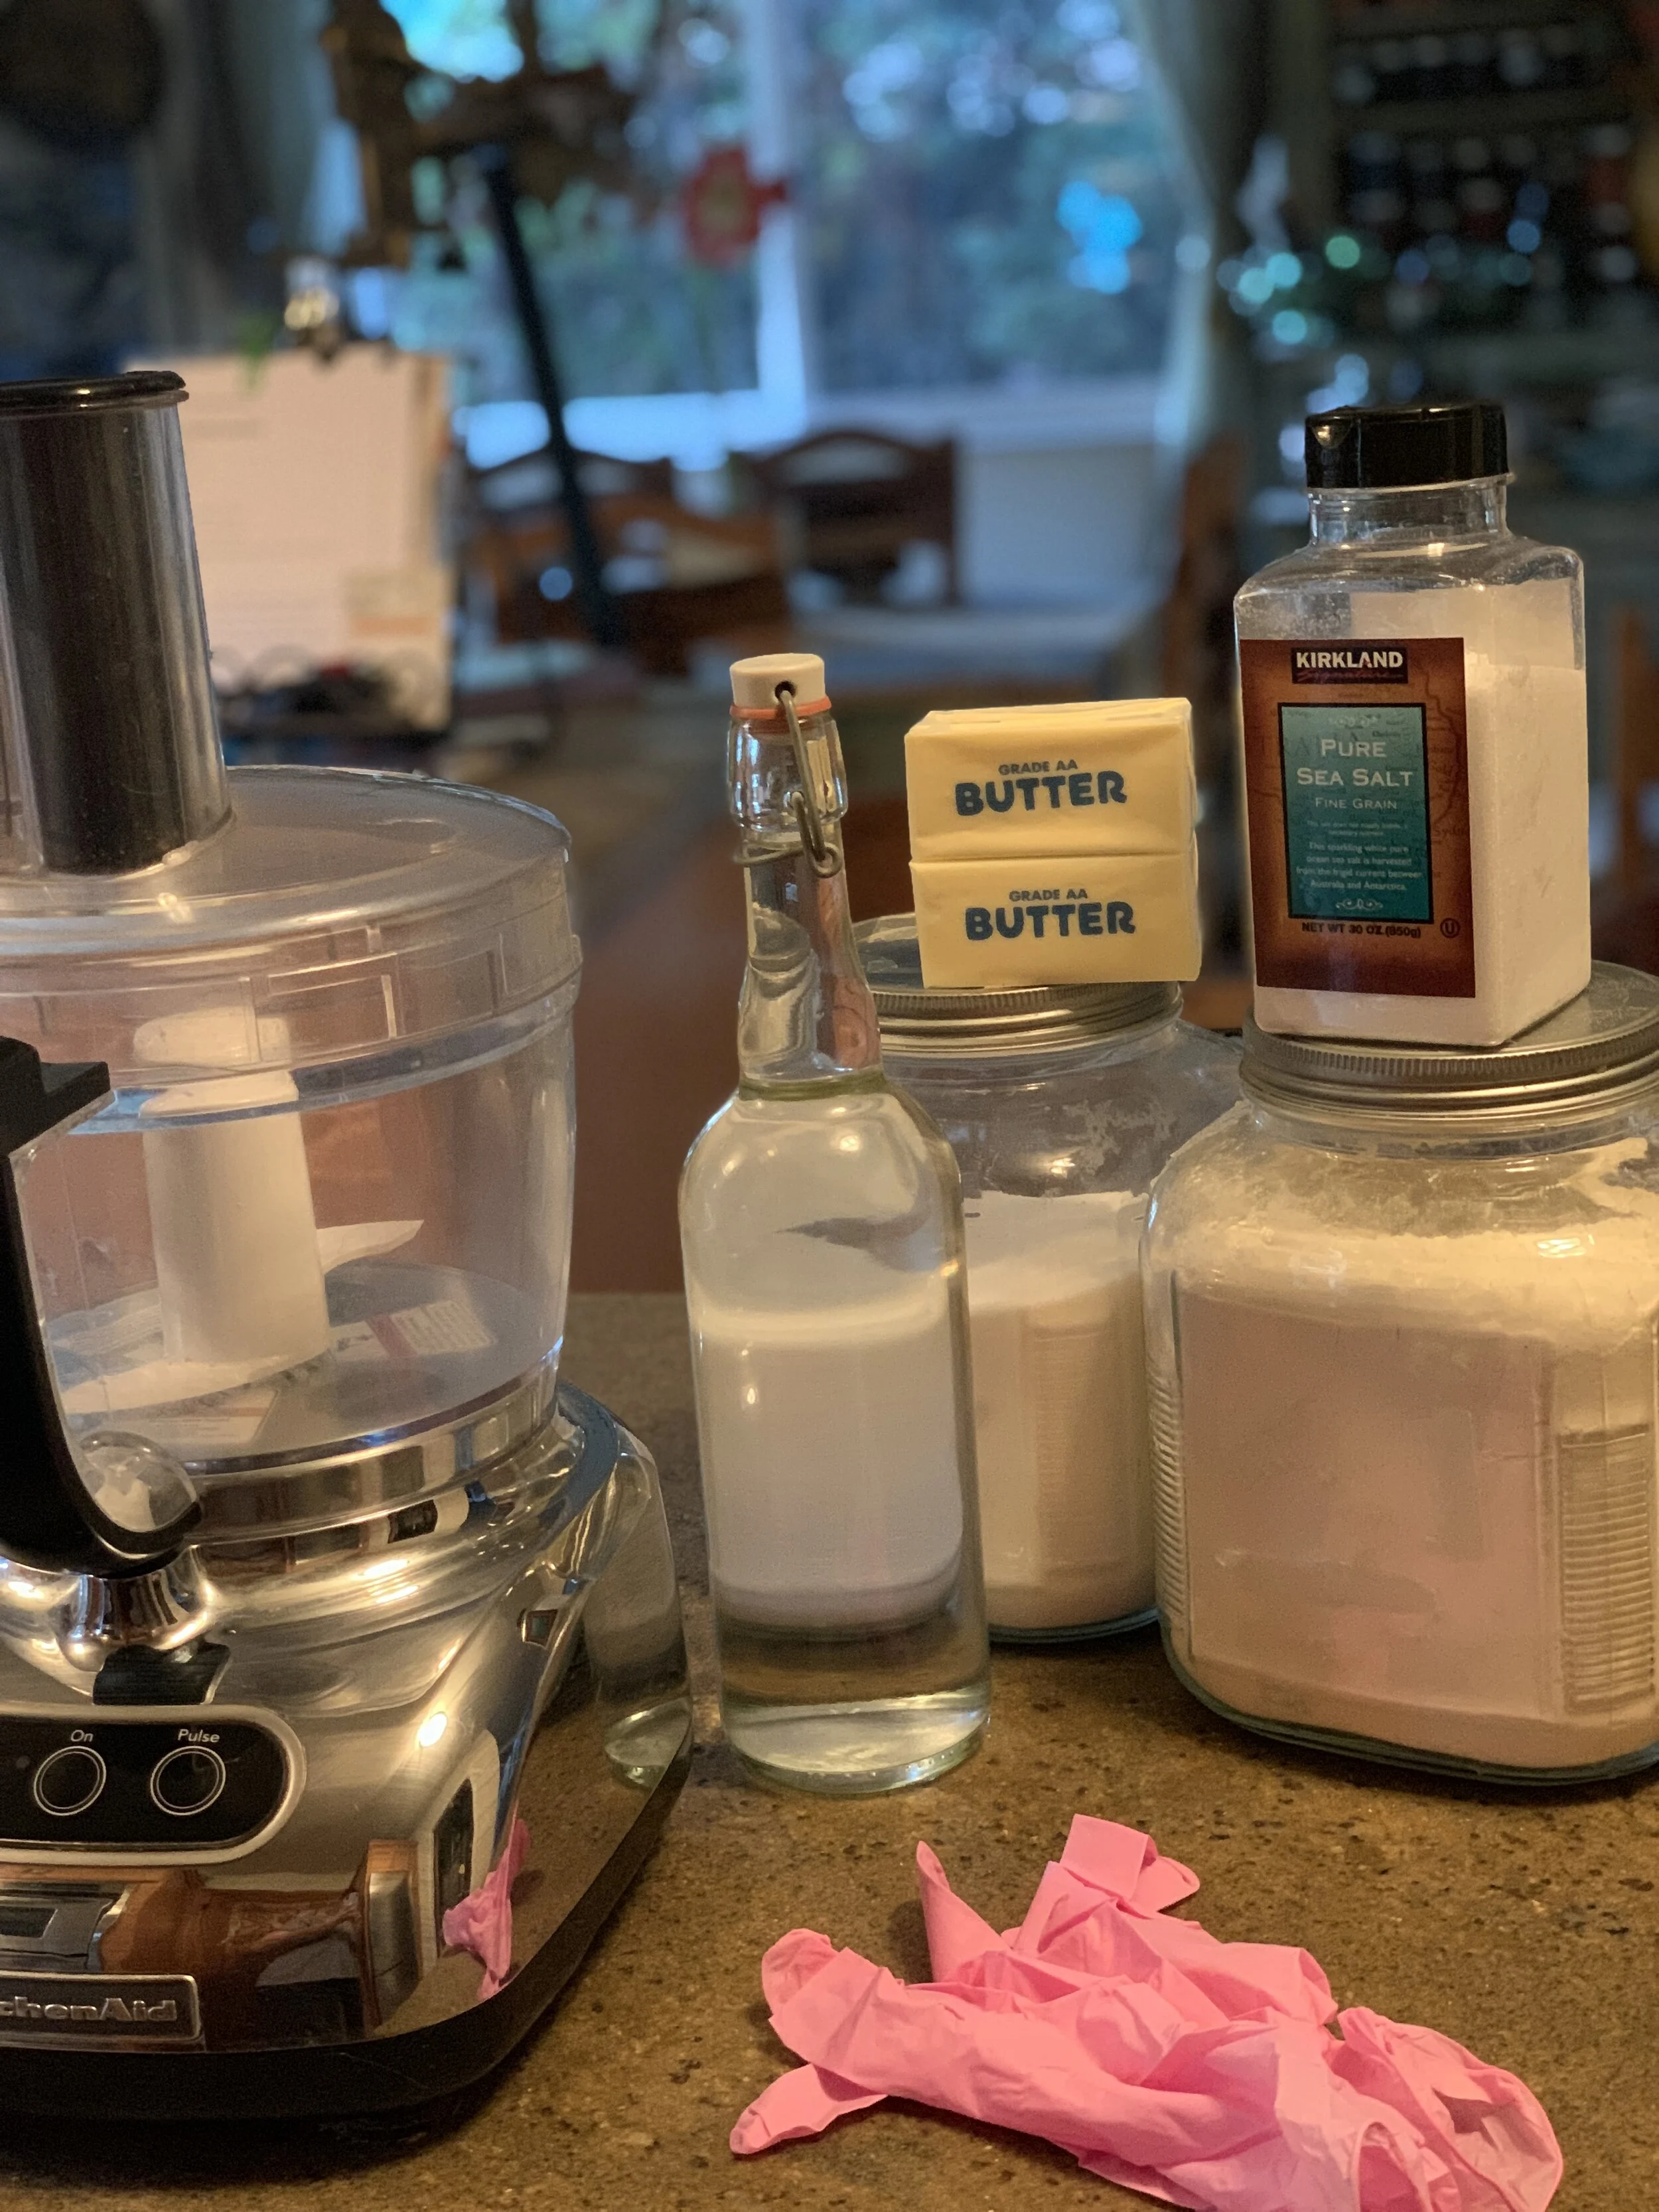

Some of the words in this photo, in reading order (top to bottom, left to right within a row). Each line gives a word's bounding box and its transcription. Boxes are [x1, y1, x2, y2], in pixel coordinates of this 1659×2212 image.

[1296, 652, 1404, 668] KIRKLAND
[998, 761, 1050, 776] GRADE
[1056, 759, 1078, 771] AA
[955, 771, 1127, 816] BUTTER
[1009, 889, 1060, 902] GRADE
[1066, 889, 1088, 899] AA
[966, 901, 1136, 940] BUTTER
[1301, 922, 1325, 932] NET
[1327, 924, 1345, 933] WT
[1348, 924, 1363, 934] 30
[70, 1730, 94, 1742] On
[177, 1728, 220, 1743] Pulse
